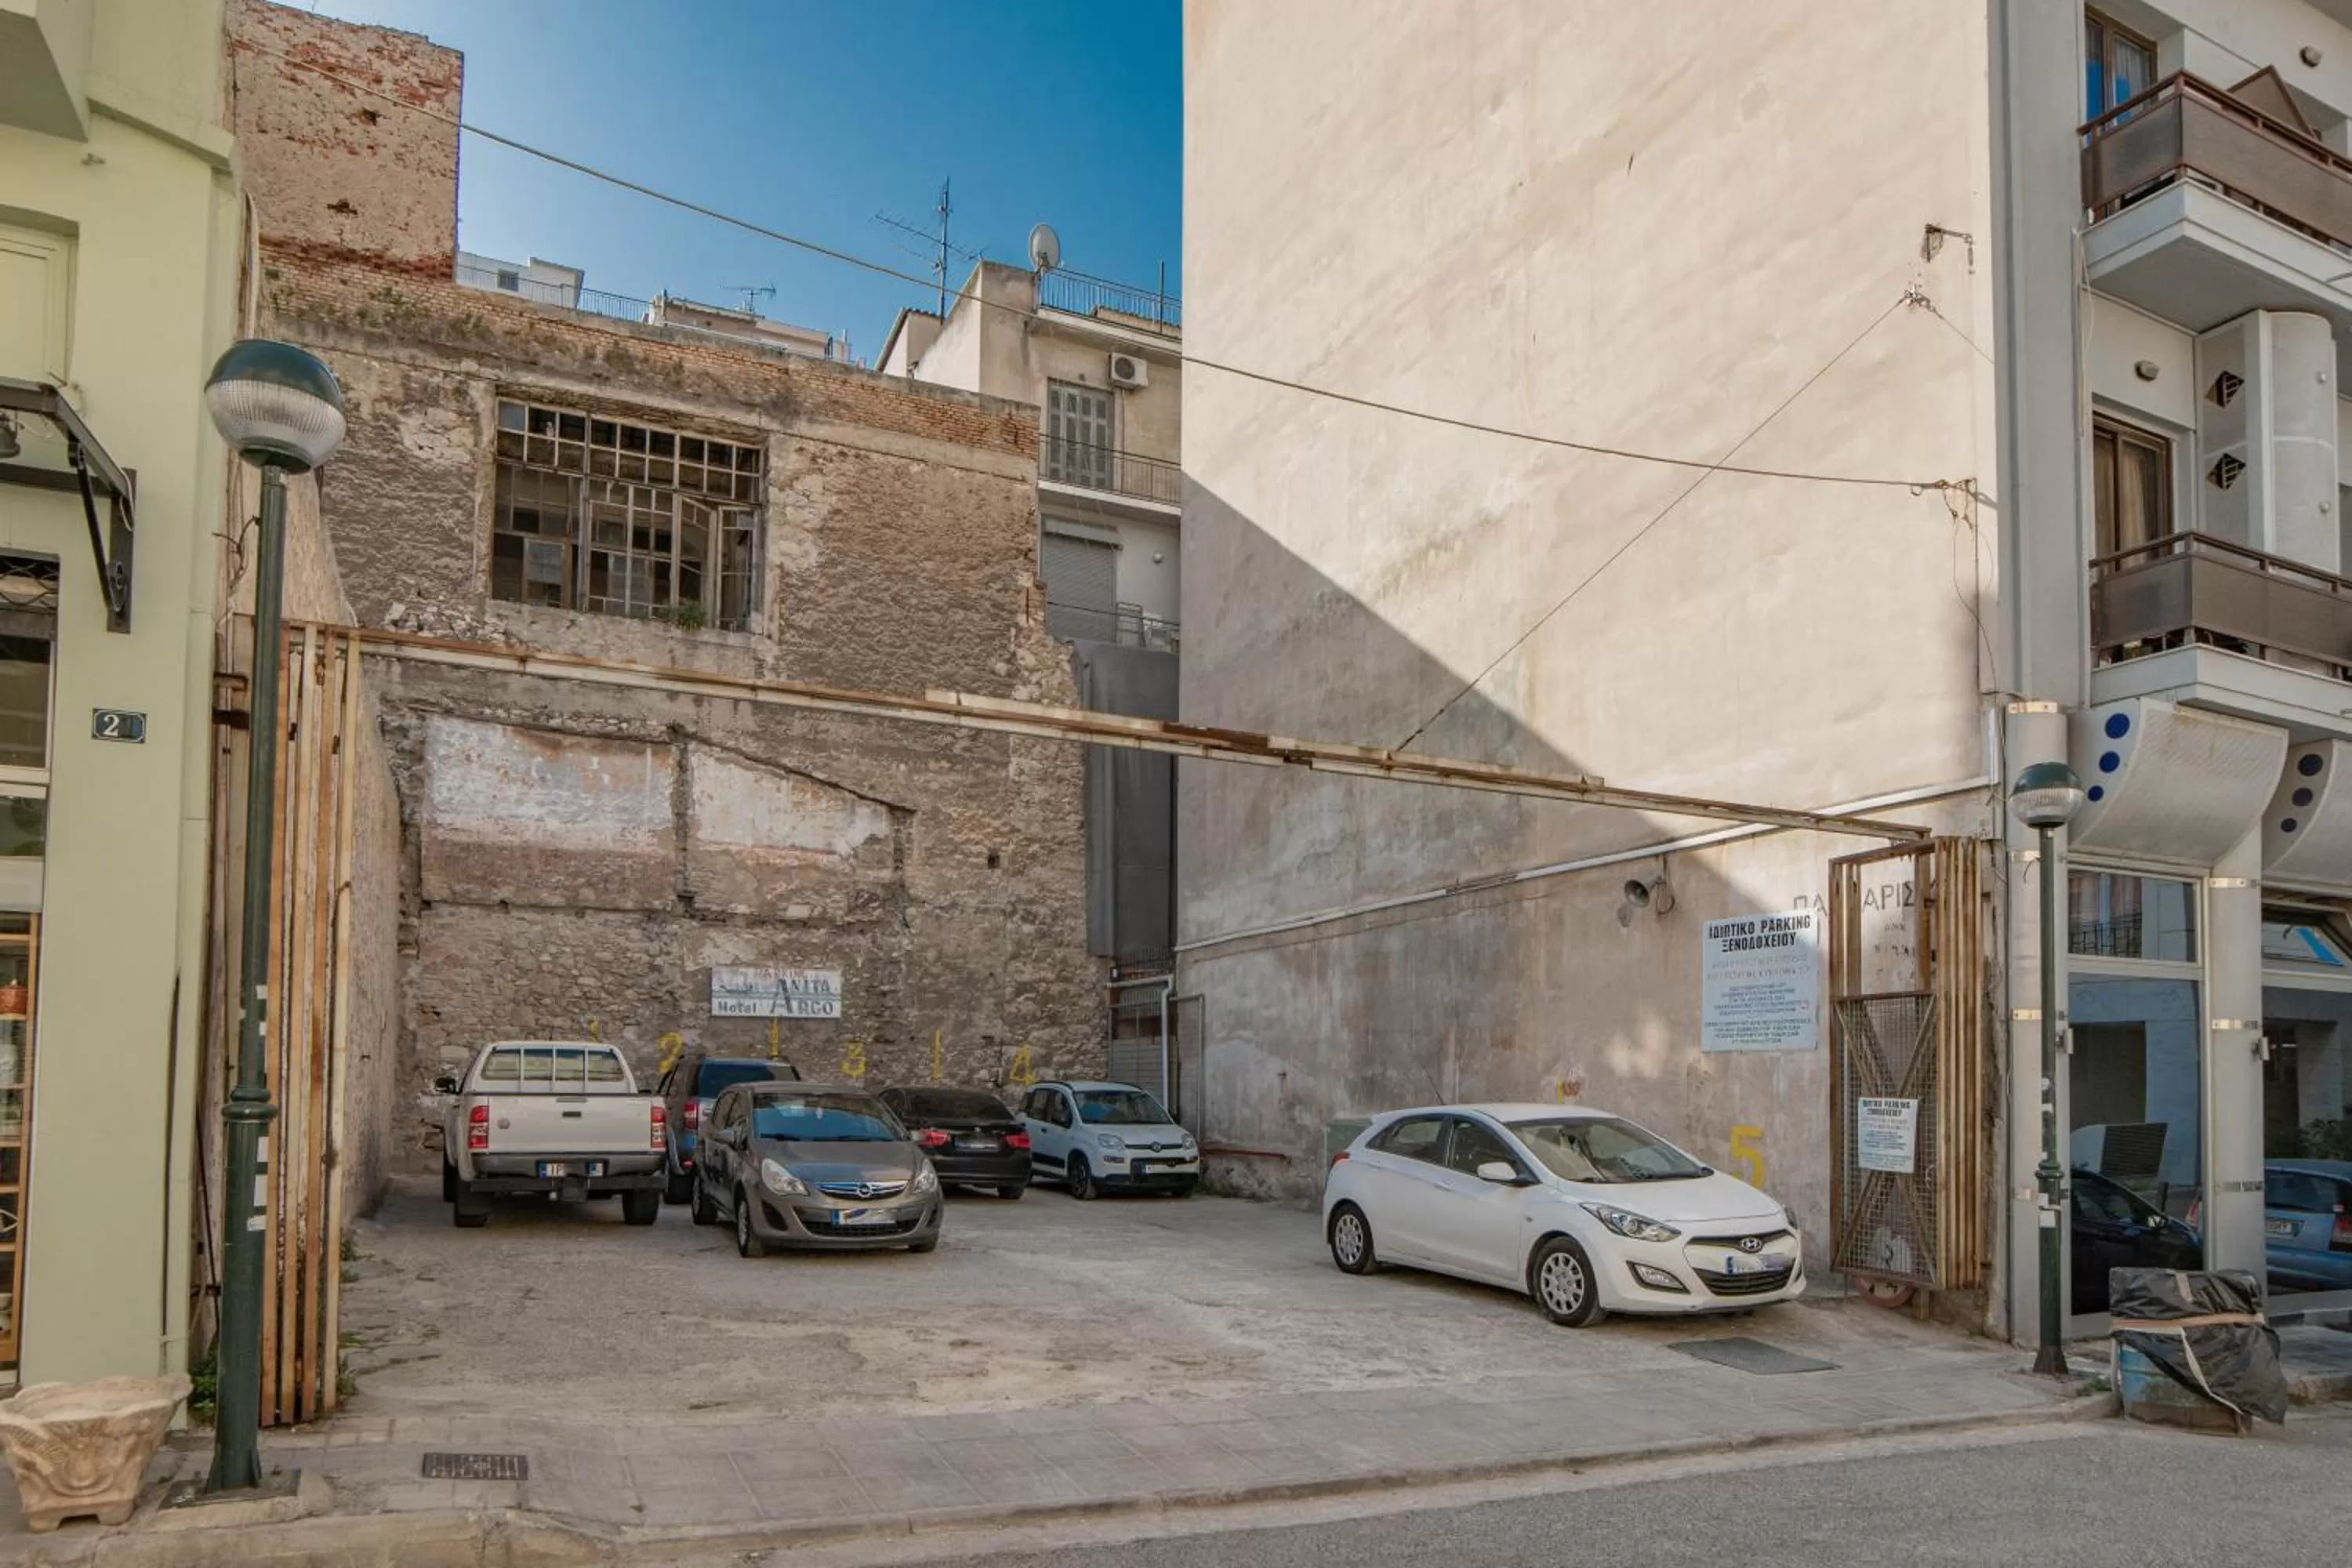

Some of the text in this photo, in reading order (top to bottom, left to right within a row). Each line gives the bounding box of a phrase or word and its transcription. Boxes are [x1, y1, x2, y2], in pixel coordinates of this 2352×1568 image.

[1760, 915, 1810, 933] PARKING
[1722, 931, 1796, 953] ΞΕΝΟΔΟΧΕΙΟΥ
[718, 1001, 757, 1014] Hotel
[1730, 1124, 1766, 1190] 5
